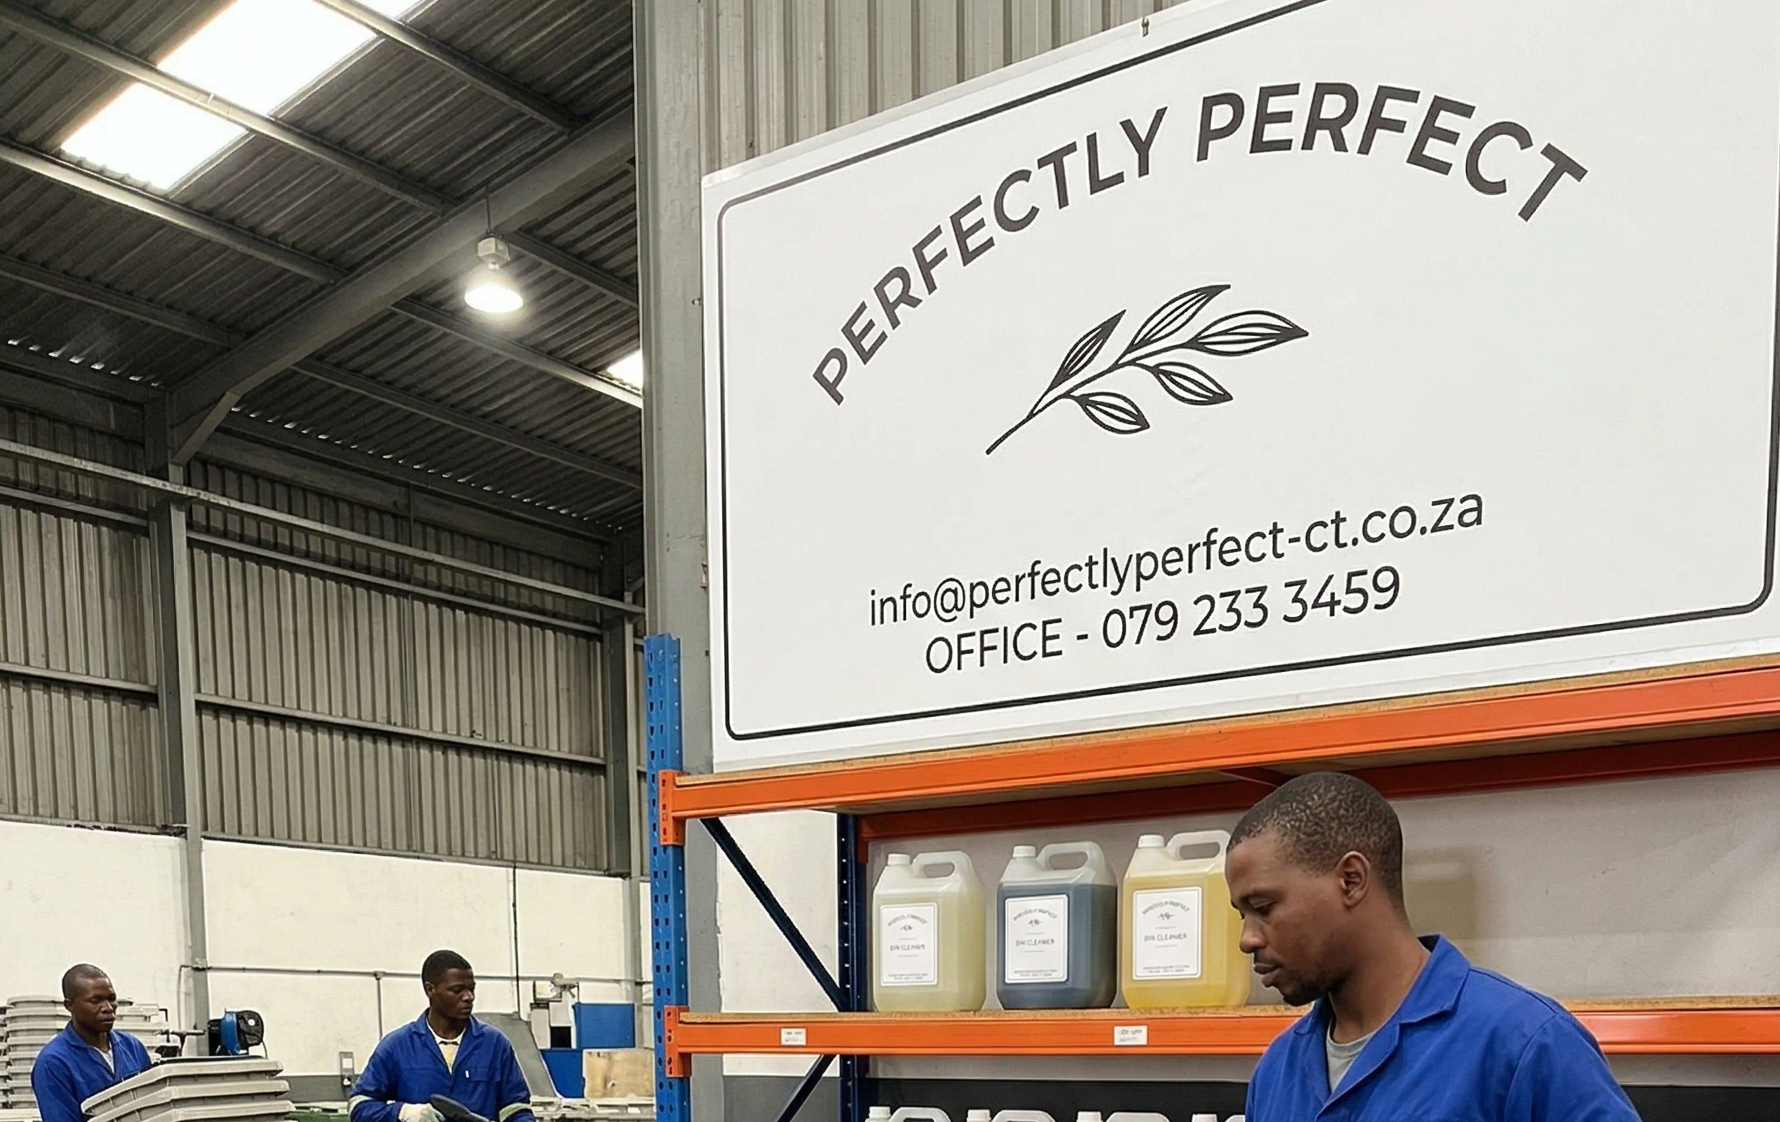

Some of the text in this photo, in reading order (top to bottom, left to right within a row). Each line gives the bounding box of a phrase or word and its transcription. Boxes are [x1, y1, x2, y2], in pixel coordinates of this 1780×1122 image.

[812, 82, 1589, 406] PERFECTLY PERFECT
[870, 493, 1484, 628] info@perfectlyperfect-ct.co.za
[925, 565, 1400, 674] OFFICE - 079 233 3459
